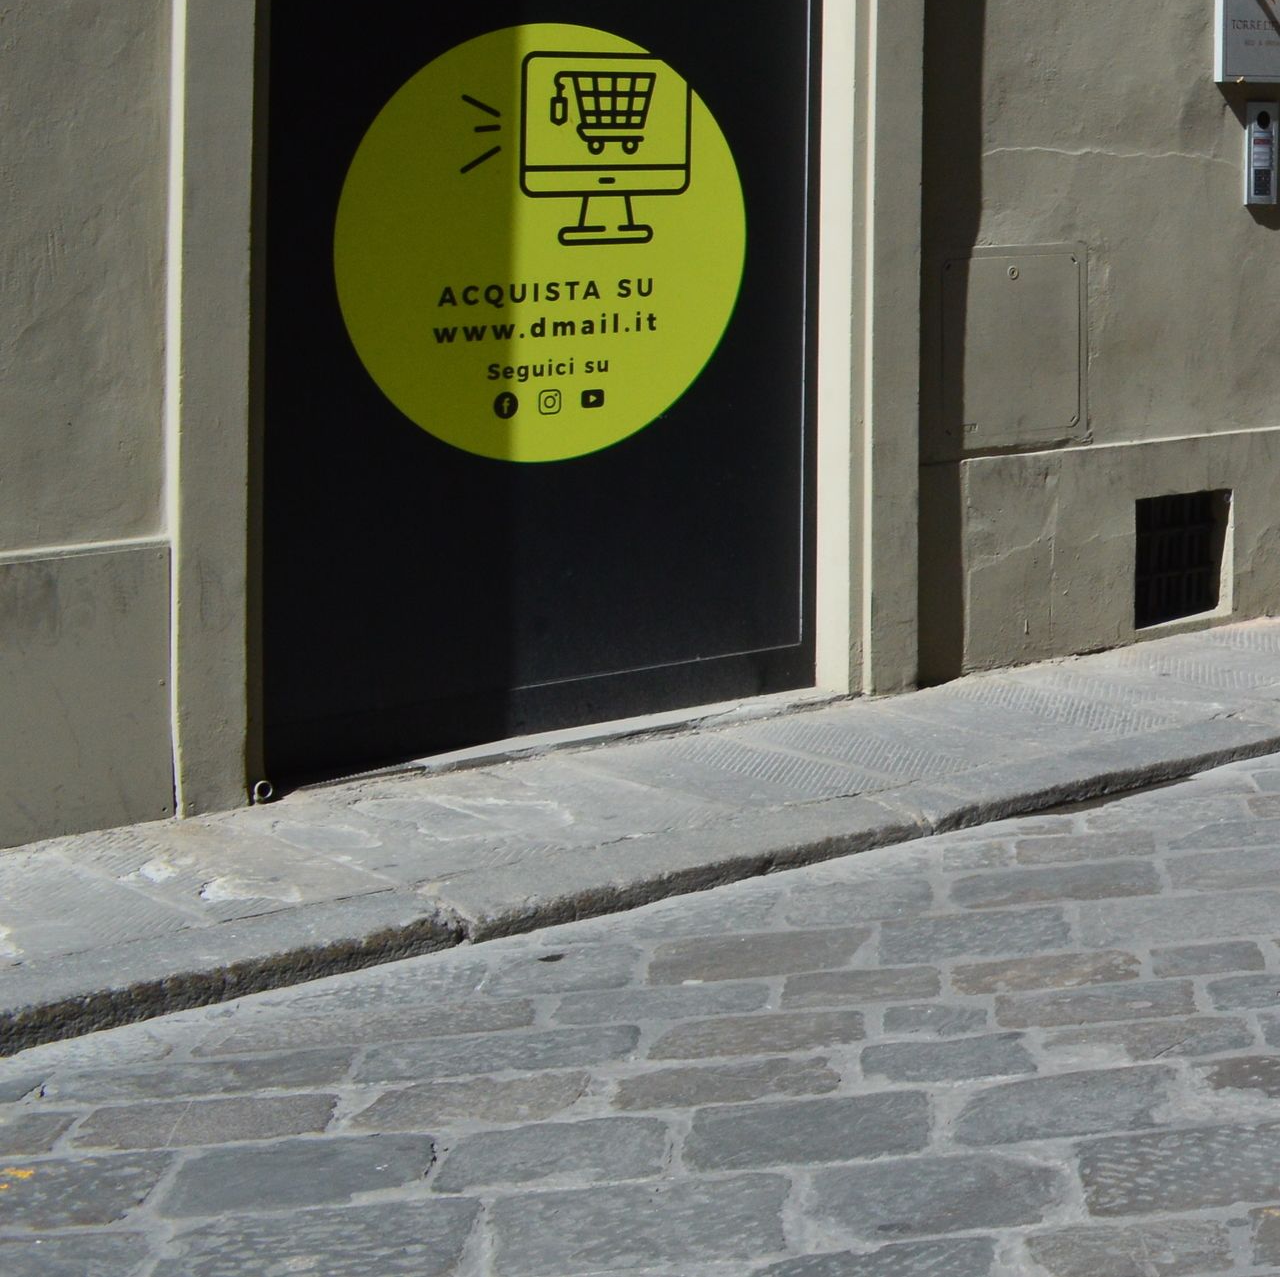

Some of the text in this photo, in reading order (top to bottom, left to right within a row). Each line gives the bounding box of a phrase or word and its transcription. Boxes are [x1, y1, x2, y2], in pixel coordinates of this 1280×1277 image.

[1232, 19, 1262, 30] TORRE
[438, 278, 654, 308] ACQUISTA SU
[433, 312, 658, 344] www.dmail.it
[487, 358, 610, 383] Seguici su
